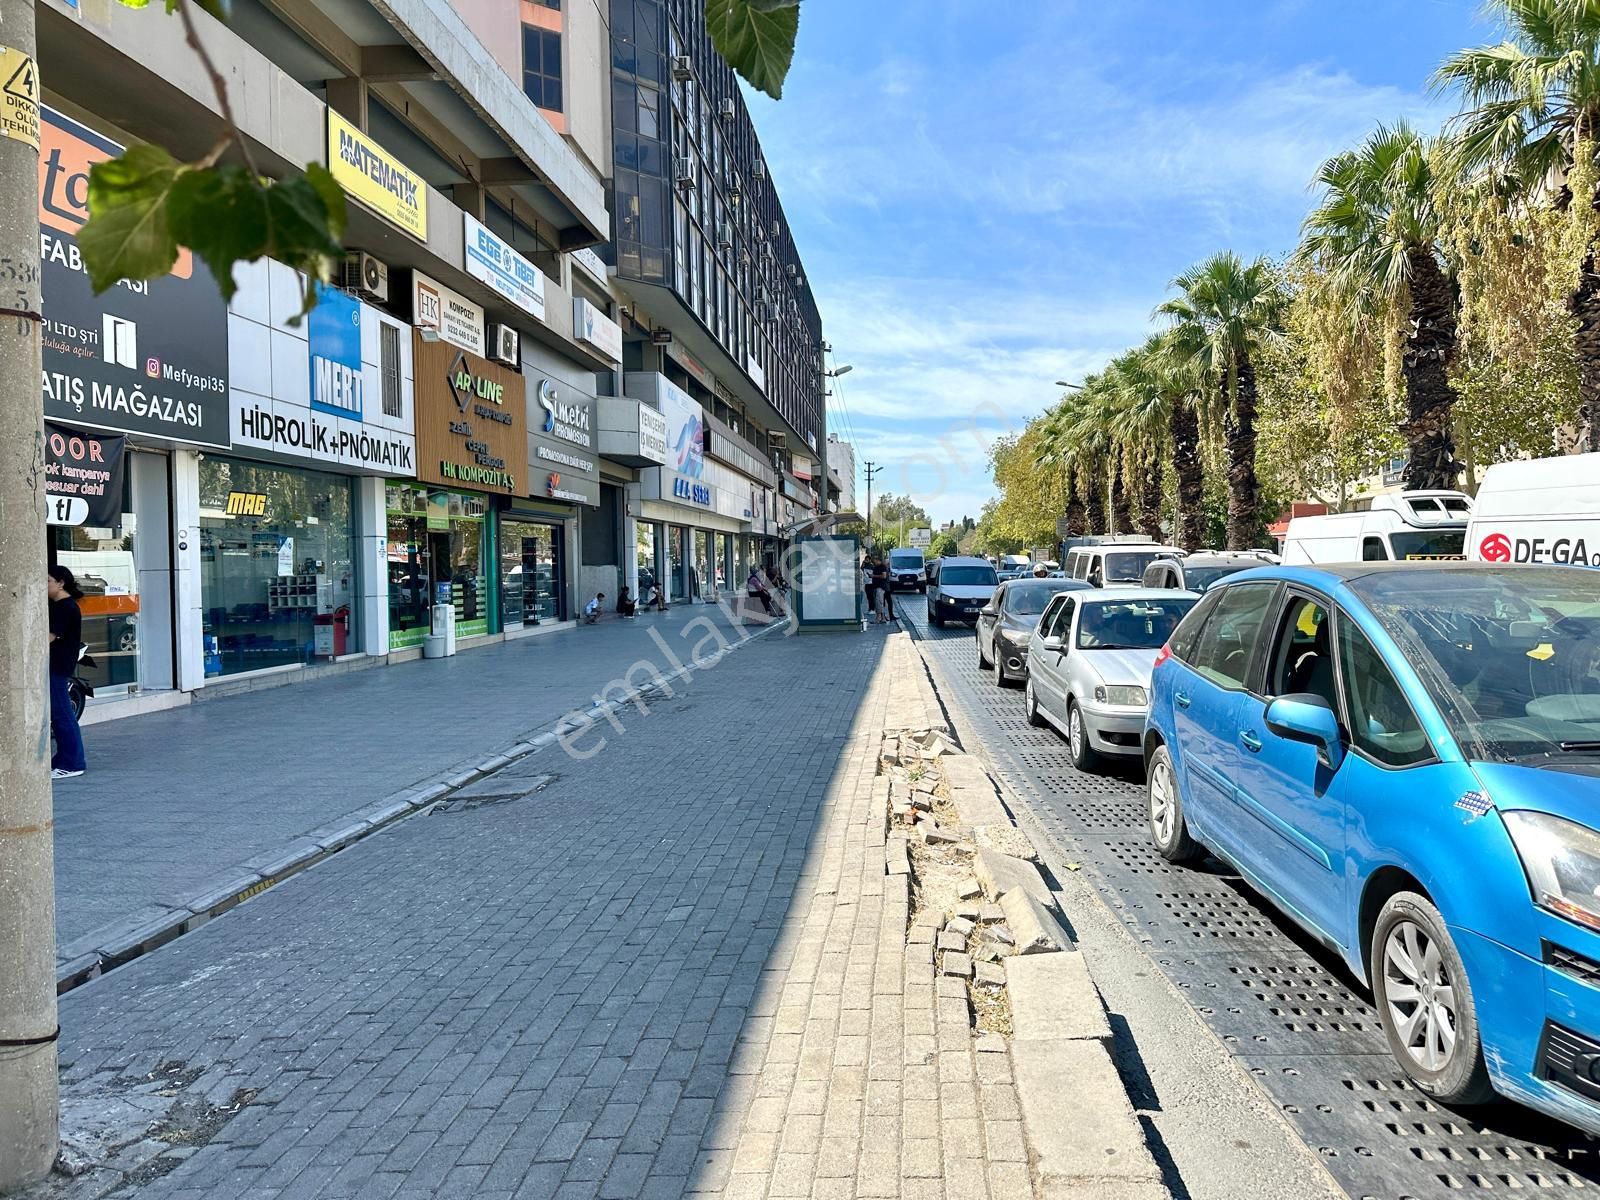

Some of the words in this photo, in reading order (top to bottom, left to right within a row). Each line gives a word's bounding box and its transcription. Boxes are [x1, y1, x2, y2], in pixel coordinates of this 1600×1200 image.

[339, 128, 418, 210] MATEMATİK
[421, 293, 438, 320] HK
[54, 321, 77, 338] LTD
[79, 329, 98, 345] ŞTİ
[163, 363, 225, 393] Mefyapi35
[313, 355, 363, 413] MERT
[455, 371, 471, 393] AR
[92, 380, 202, 428] MAĞAZASI
[62, 463, 110, 483] kampanya
[442, 461, 456, 479] HK
[458, 465, 500, 486] KOMPOZİT
[227, 492, 267, 516] MAG
[1514, 538, 1588, 565] DE-GA
